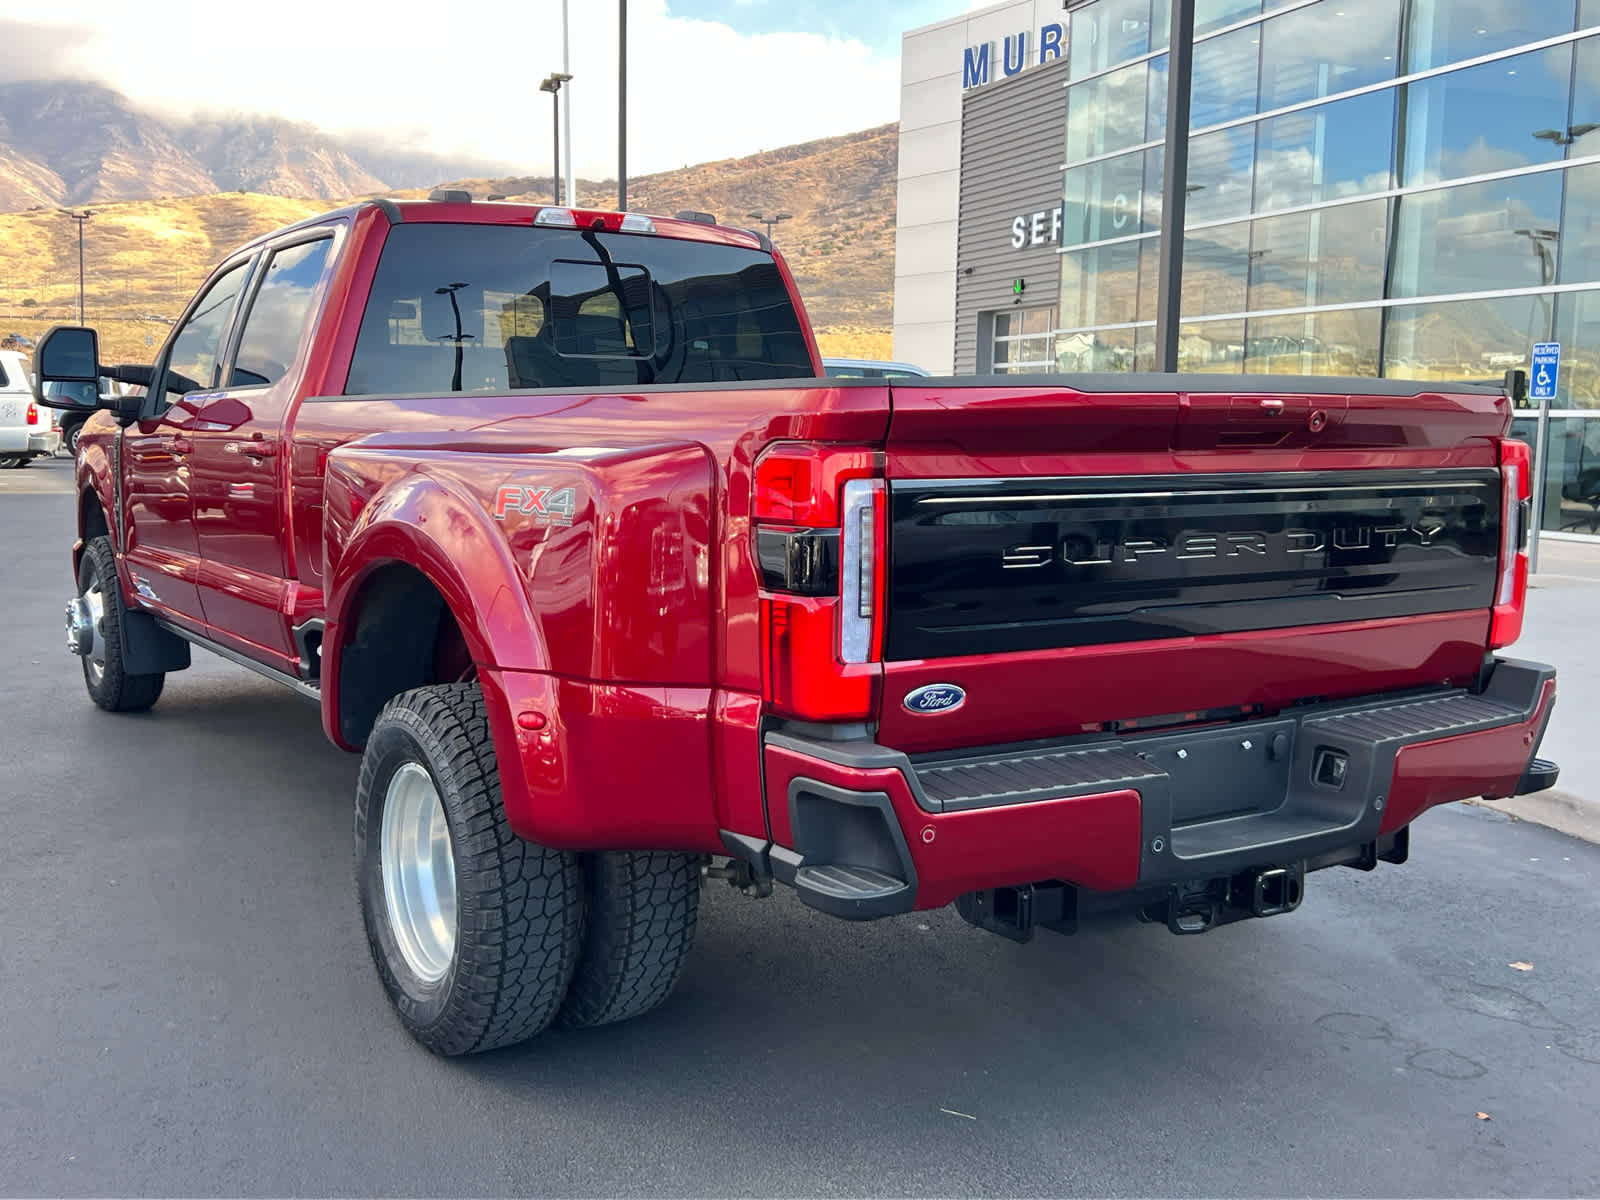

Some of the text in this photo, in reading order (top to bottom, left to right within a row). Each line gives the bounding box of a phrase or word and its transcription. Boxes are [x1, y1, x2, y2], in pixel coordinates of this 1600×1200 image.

[962, 23, 1066, 90] MUR
[1535, 387, 1550, 395] ONLY
[494, 485, 576, 521] FX4
[1001, 525, 1442, 569] SUPER DUTY
[919, 690, 954, 708] Ford
